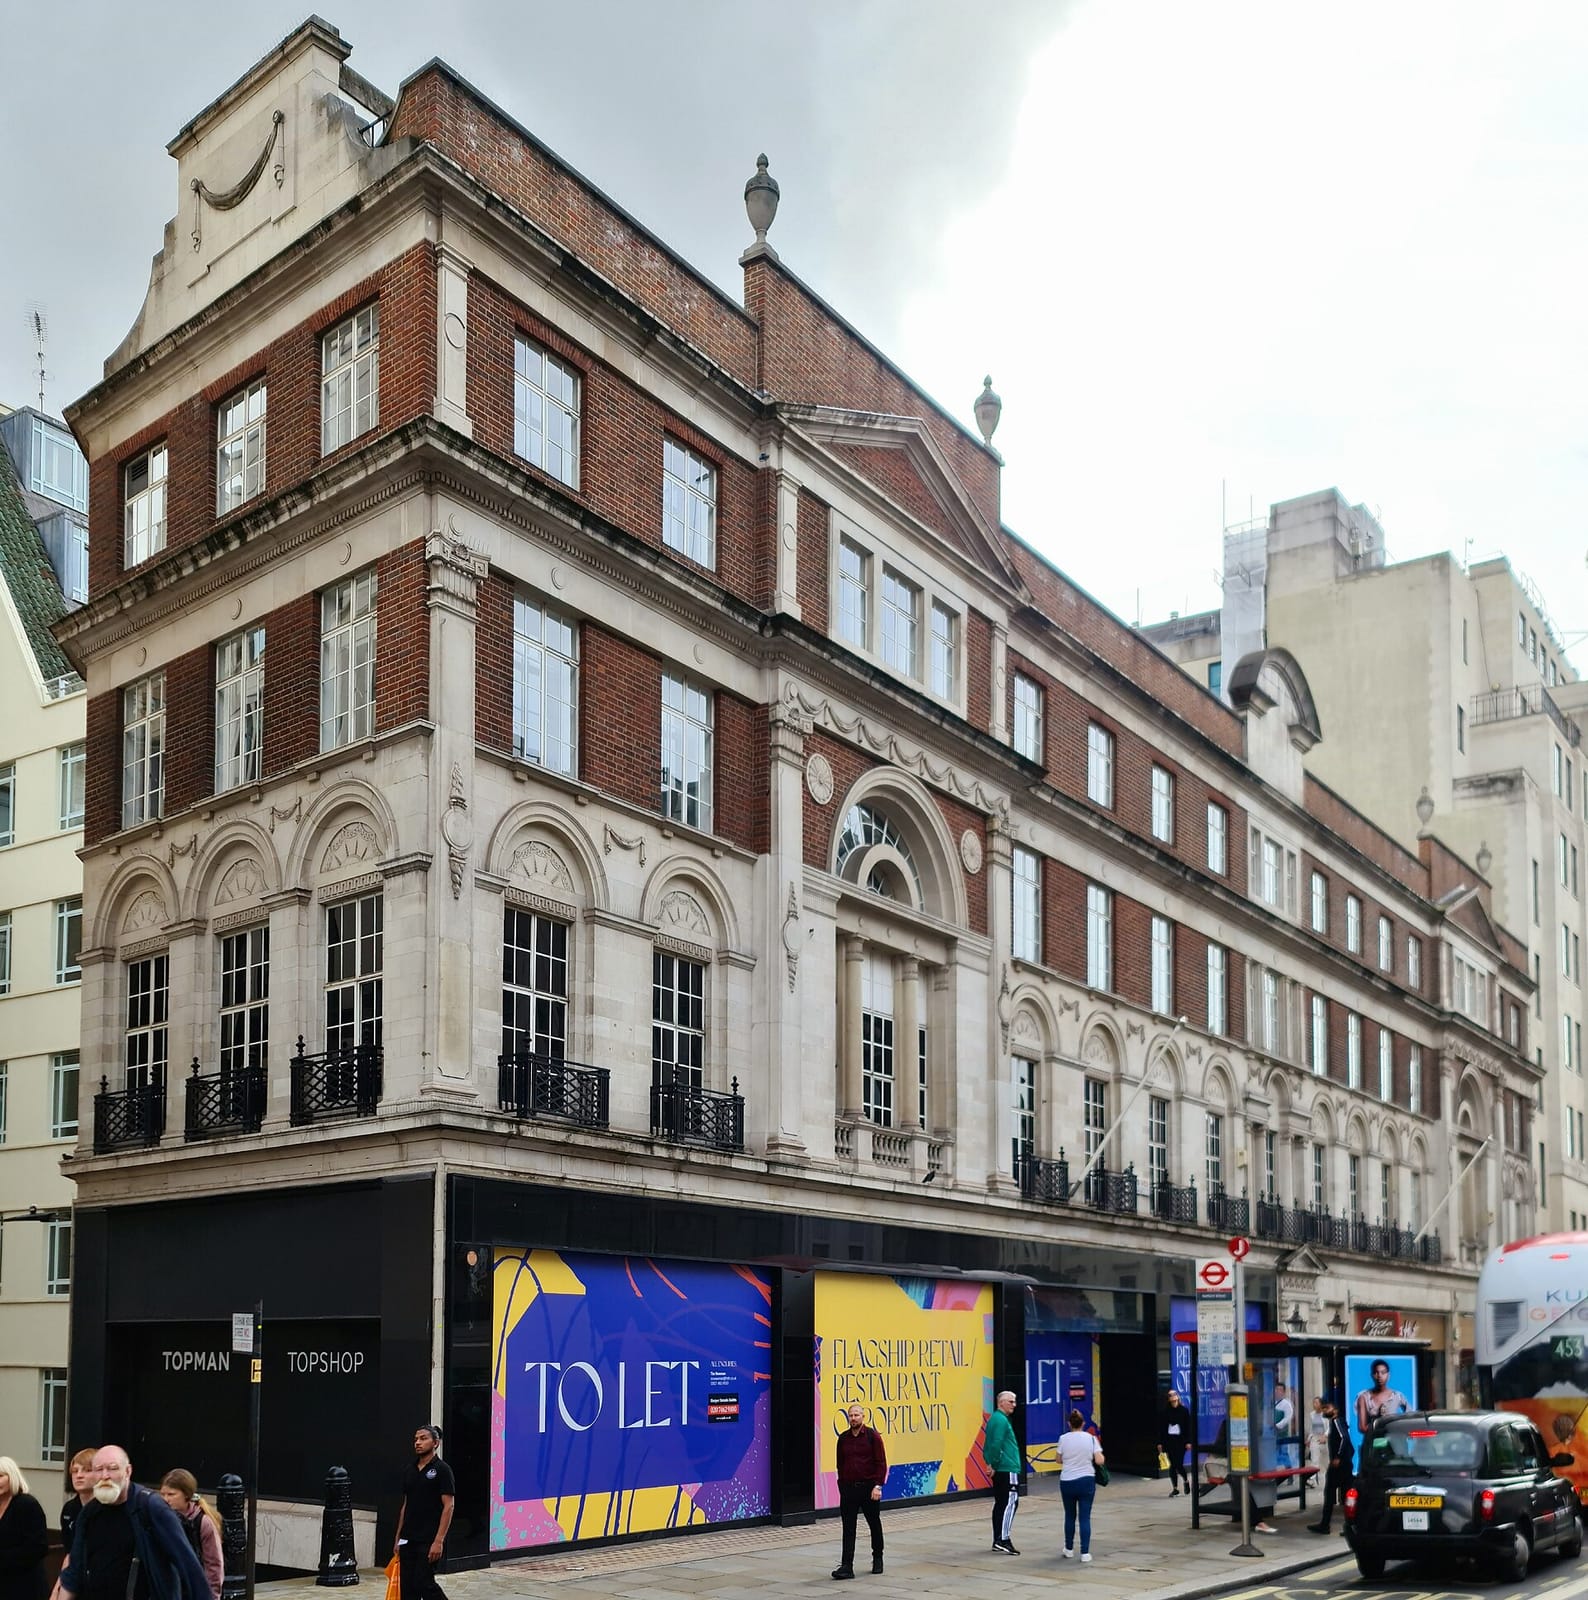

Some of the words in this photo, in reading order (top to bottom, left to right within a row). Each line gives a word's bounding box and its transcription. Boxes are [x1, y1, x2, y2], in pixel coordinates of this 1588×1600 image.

[1233, 1239, 1243, 1255] J
[1546, 1289, 1588, 1303] KU
[1363, 1317, 1393, 1330] Pizza
[833, 1338, 915, 1368] FLAGSHIP
[919, 1339, 969, 1367] RETAIL
[1554, 1339, 1584, 1358] 453
[162, 1351, 230, 1371] TOPMAN
[287, 1351, 364, 1373] TOPSHOP
[833, 1372, 941, 1403] RESTAURANT
[1026, 1359, 1065, 1404] LET
[1176, 1370, 1211, 1391] OFCE
[525, 1361, 603, 1432] TO
[619, 1361, 699, 1429] LET
[833, 1403, 952, 1437] OPORTUNITY
[1395, 1496, 1416, 1505] KF15
[1418, 1496, 1436, 1505] AXP
